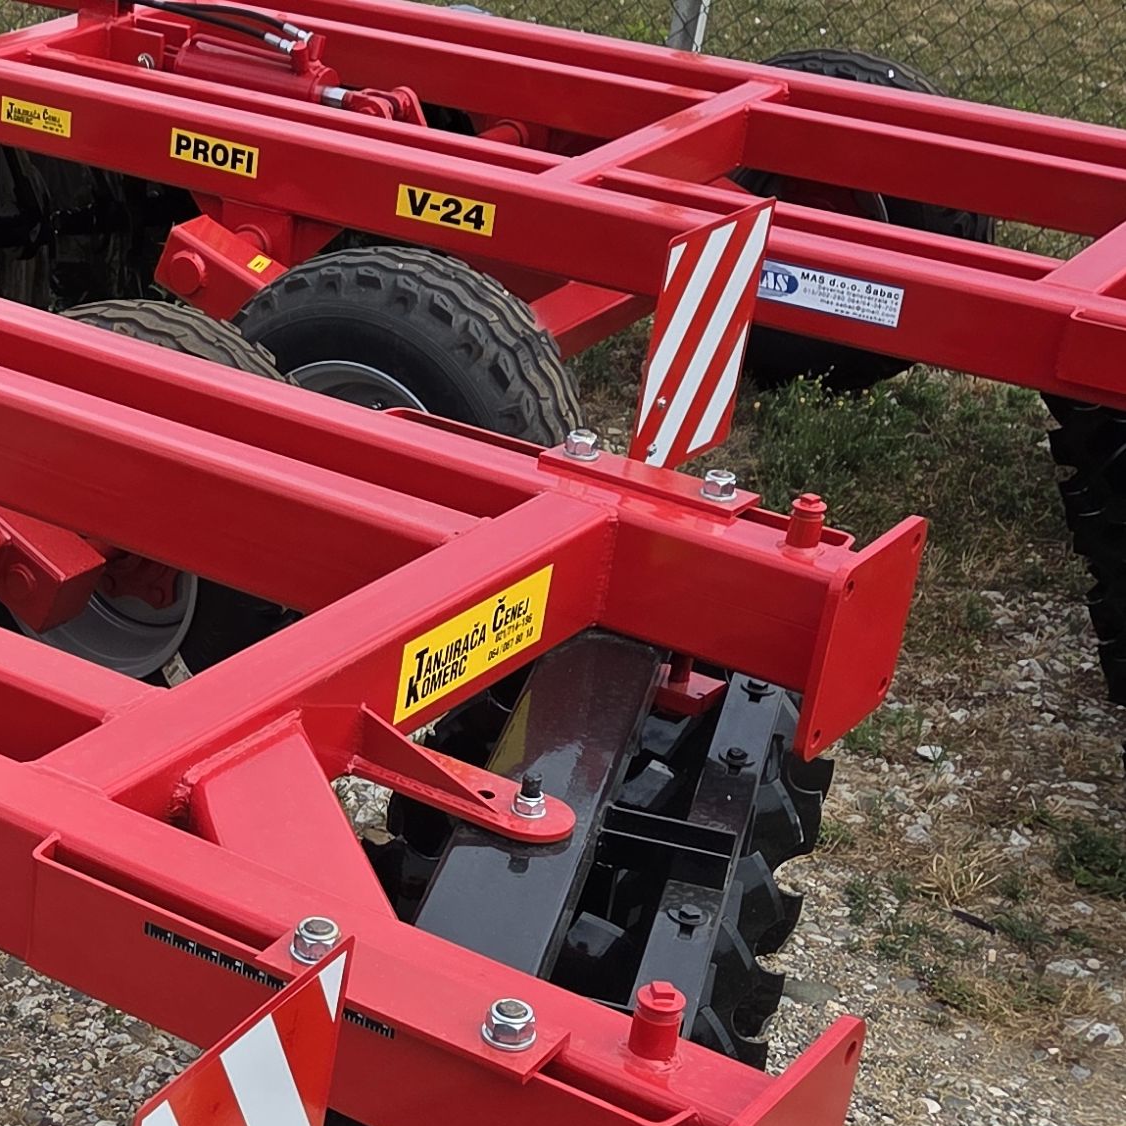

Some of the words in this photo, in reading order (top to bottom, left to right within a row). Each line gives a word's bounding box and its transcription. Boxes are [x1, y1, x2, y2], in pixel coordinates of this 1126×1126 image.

[175, 133, 254, 174] PROFI
[407, 188, 485, 230] V-24
[760, 271, 789, 292] AS
[800, 271, 825, 284] MAS
[829, 278, 861, 293] d.o.o.
[865, 284, 900, 300] Šabac
[415, 622, 487, 683] TANJIRAČA
[492, 596, 530, 632] ČENEJ
[405, 655, 468, 709] KOMERC
